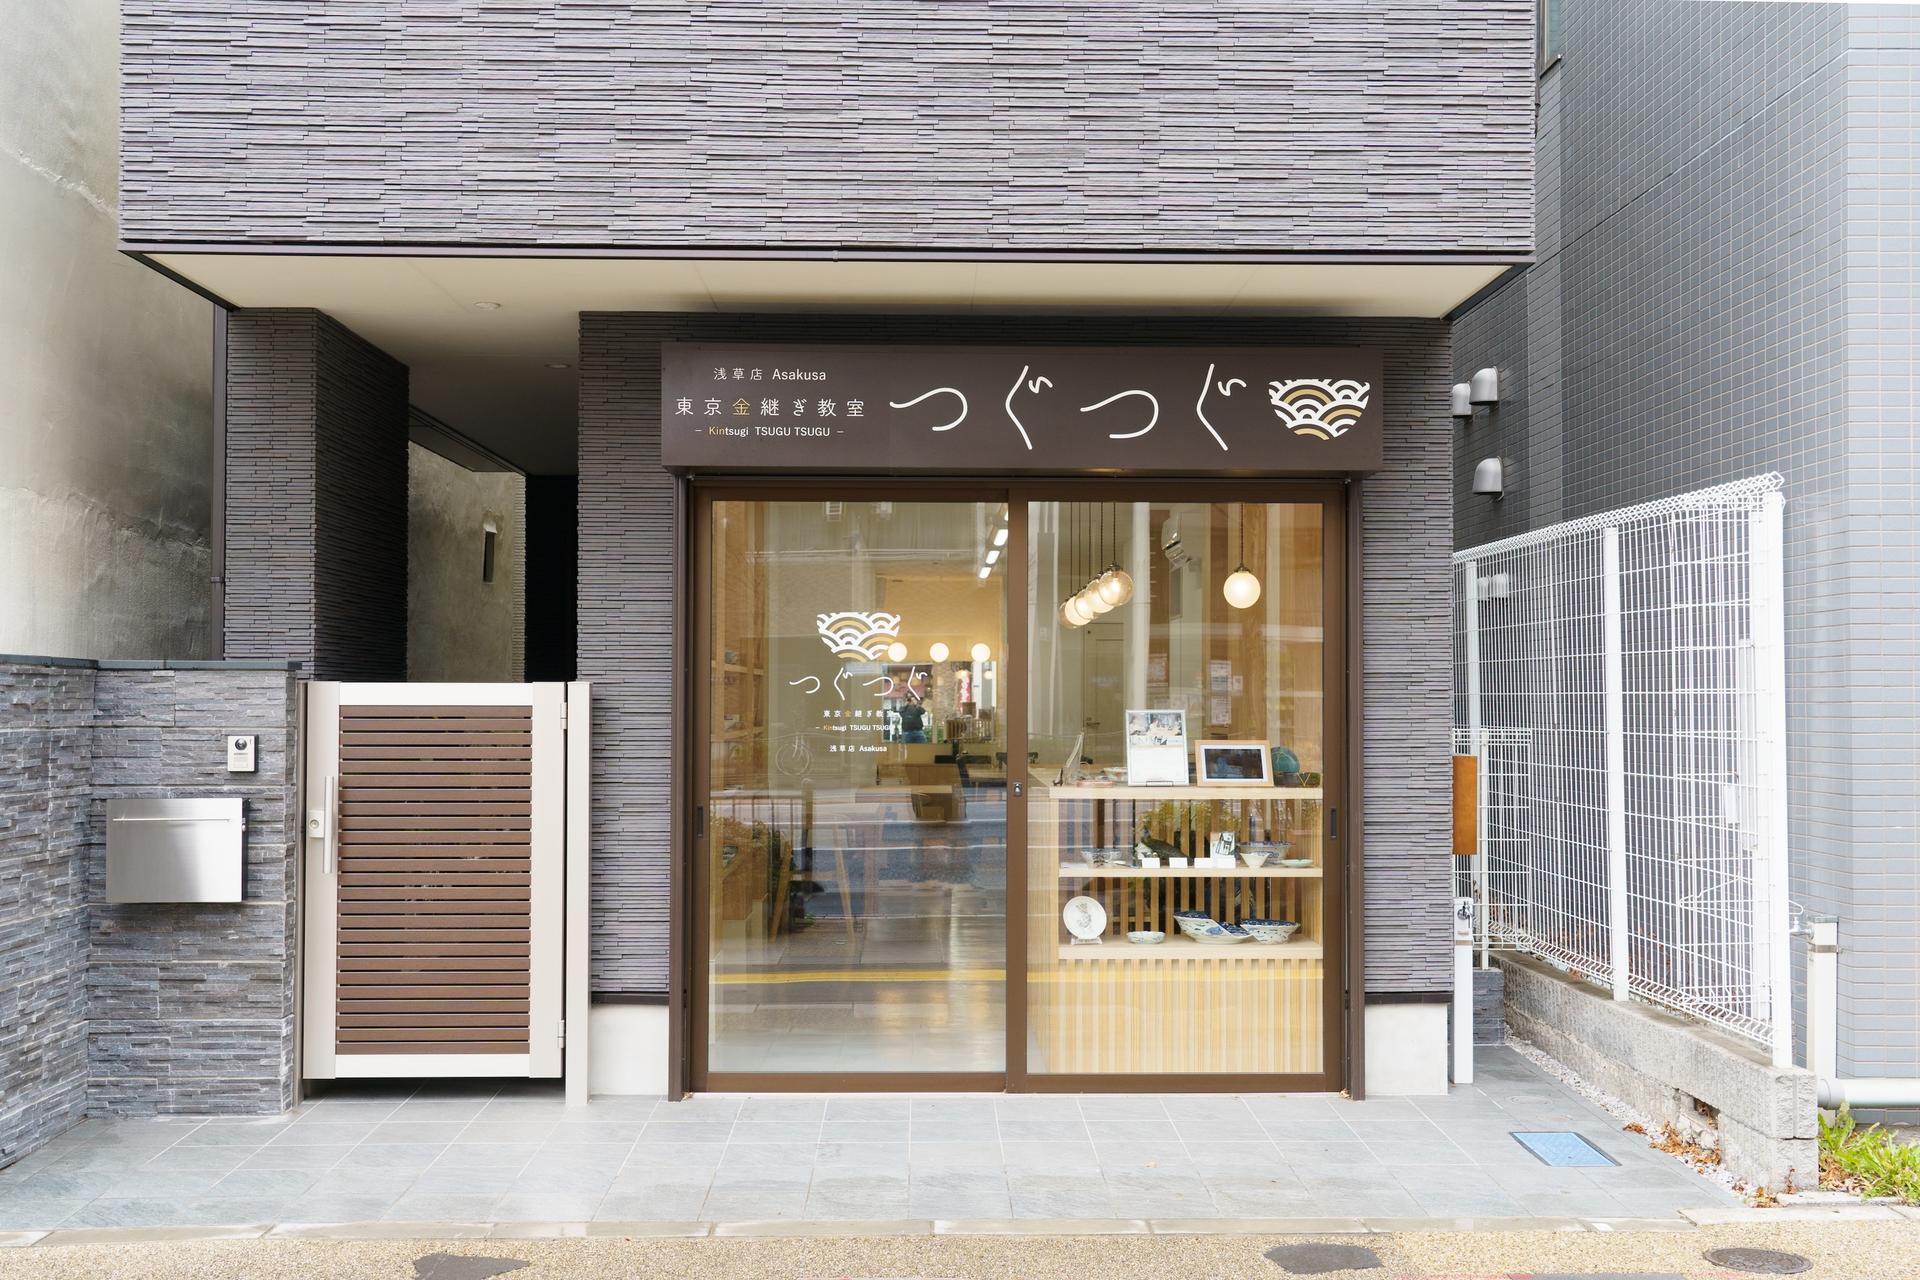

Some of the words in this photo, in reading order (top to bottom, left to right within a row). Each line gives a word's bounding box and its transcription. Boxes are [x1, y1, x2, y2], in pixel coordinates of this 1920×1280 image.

[714, 367, 763, 381] 浅草店
[772, 369, 826, 381] Asakusa
[674, 397, 865, 417] 東京金継ぎ教室
[890, 363, 1247, 451] つぐつぐ
[709, 426, 749, 438] Kintsugi
[754, 427, 791, 437] TSUGU
[793, 427, 831, 437] TSUGU
[789, 666, 928, 701] つぐつぐ
